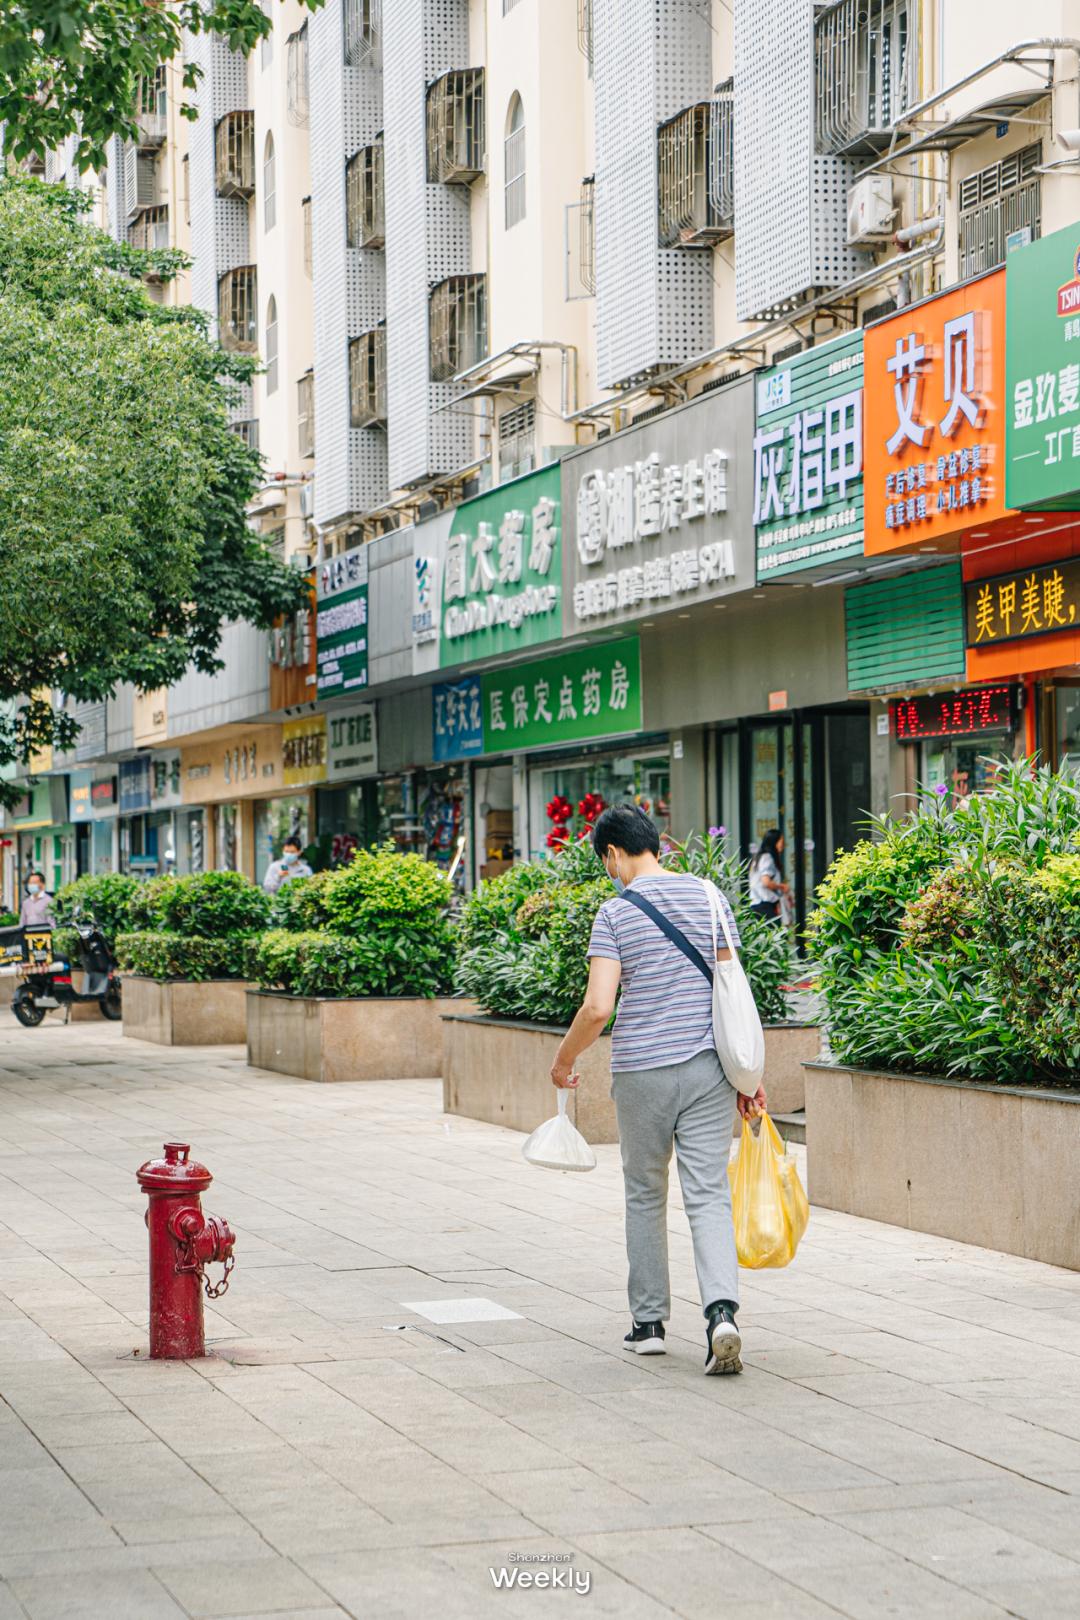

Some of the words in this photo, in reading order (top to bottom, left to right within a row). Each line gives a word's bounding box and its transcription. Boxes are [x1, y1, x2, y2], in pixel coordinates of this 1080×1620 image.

[885, 310, 980, 456] 艾贝
[753, 388, 862, 526] 灰指甲
[489, 659, 630, 731] 医保定点药房
